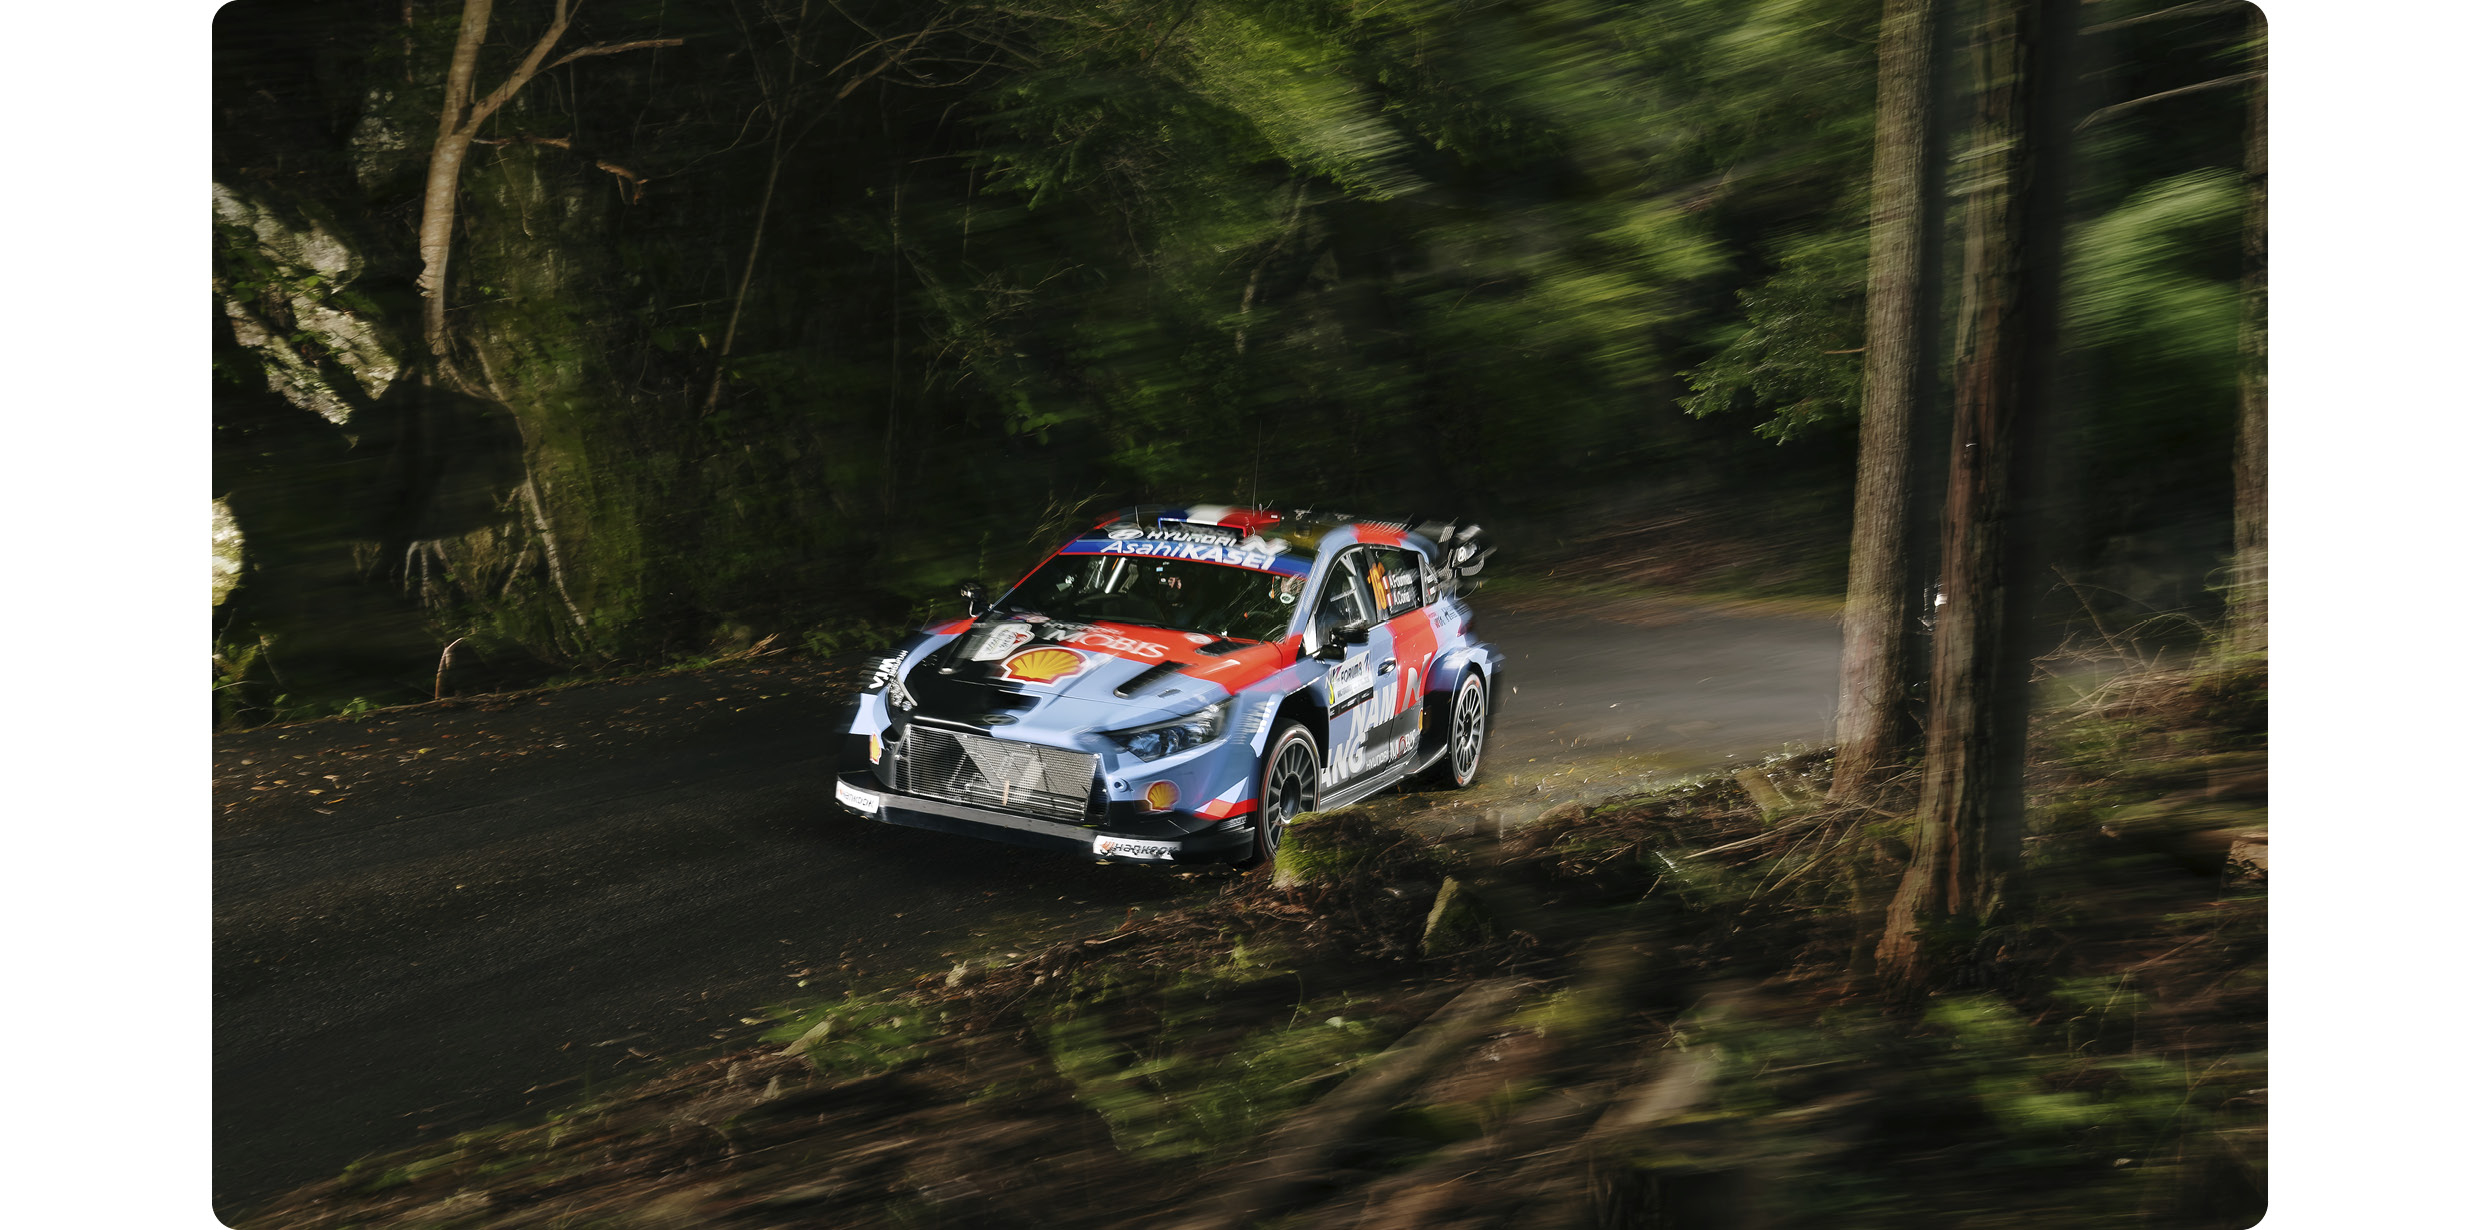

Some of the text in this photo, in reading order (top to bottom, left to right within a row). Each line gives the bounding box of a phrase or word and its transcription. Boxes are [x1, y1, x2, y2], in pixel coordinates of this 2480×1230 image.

[1147, 530, 1237, 548] HYUNDAI
[1042, 629, 1170, 658] MOBIS
[1350, 681, 1397, 742] NAM
